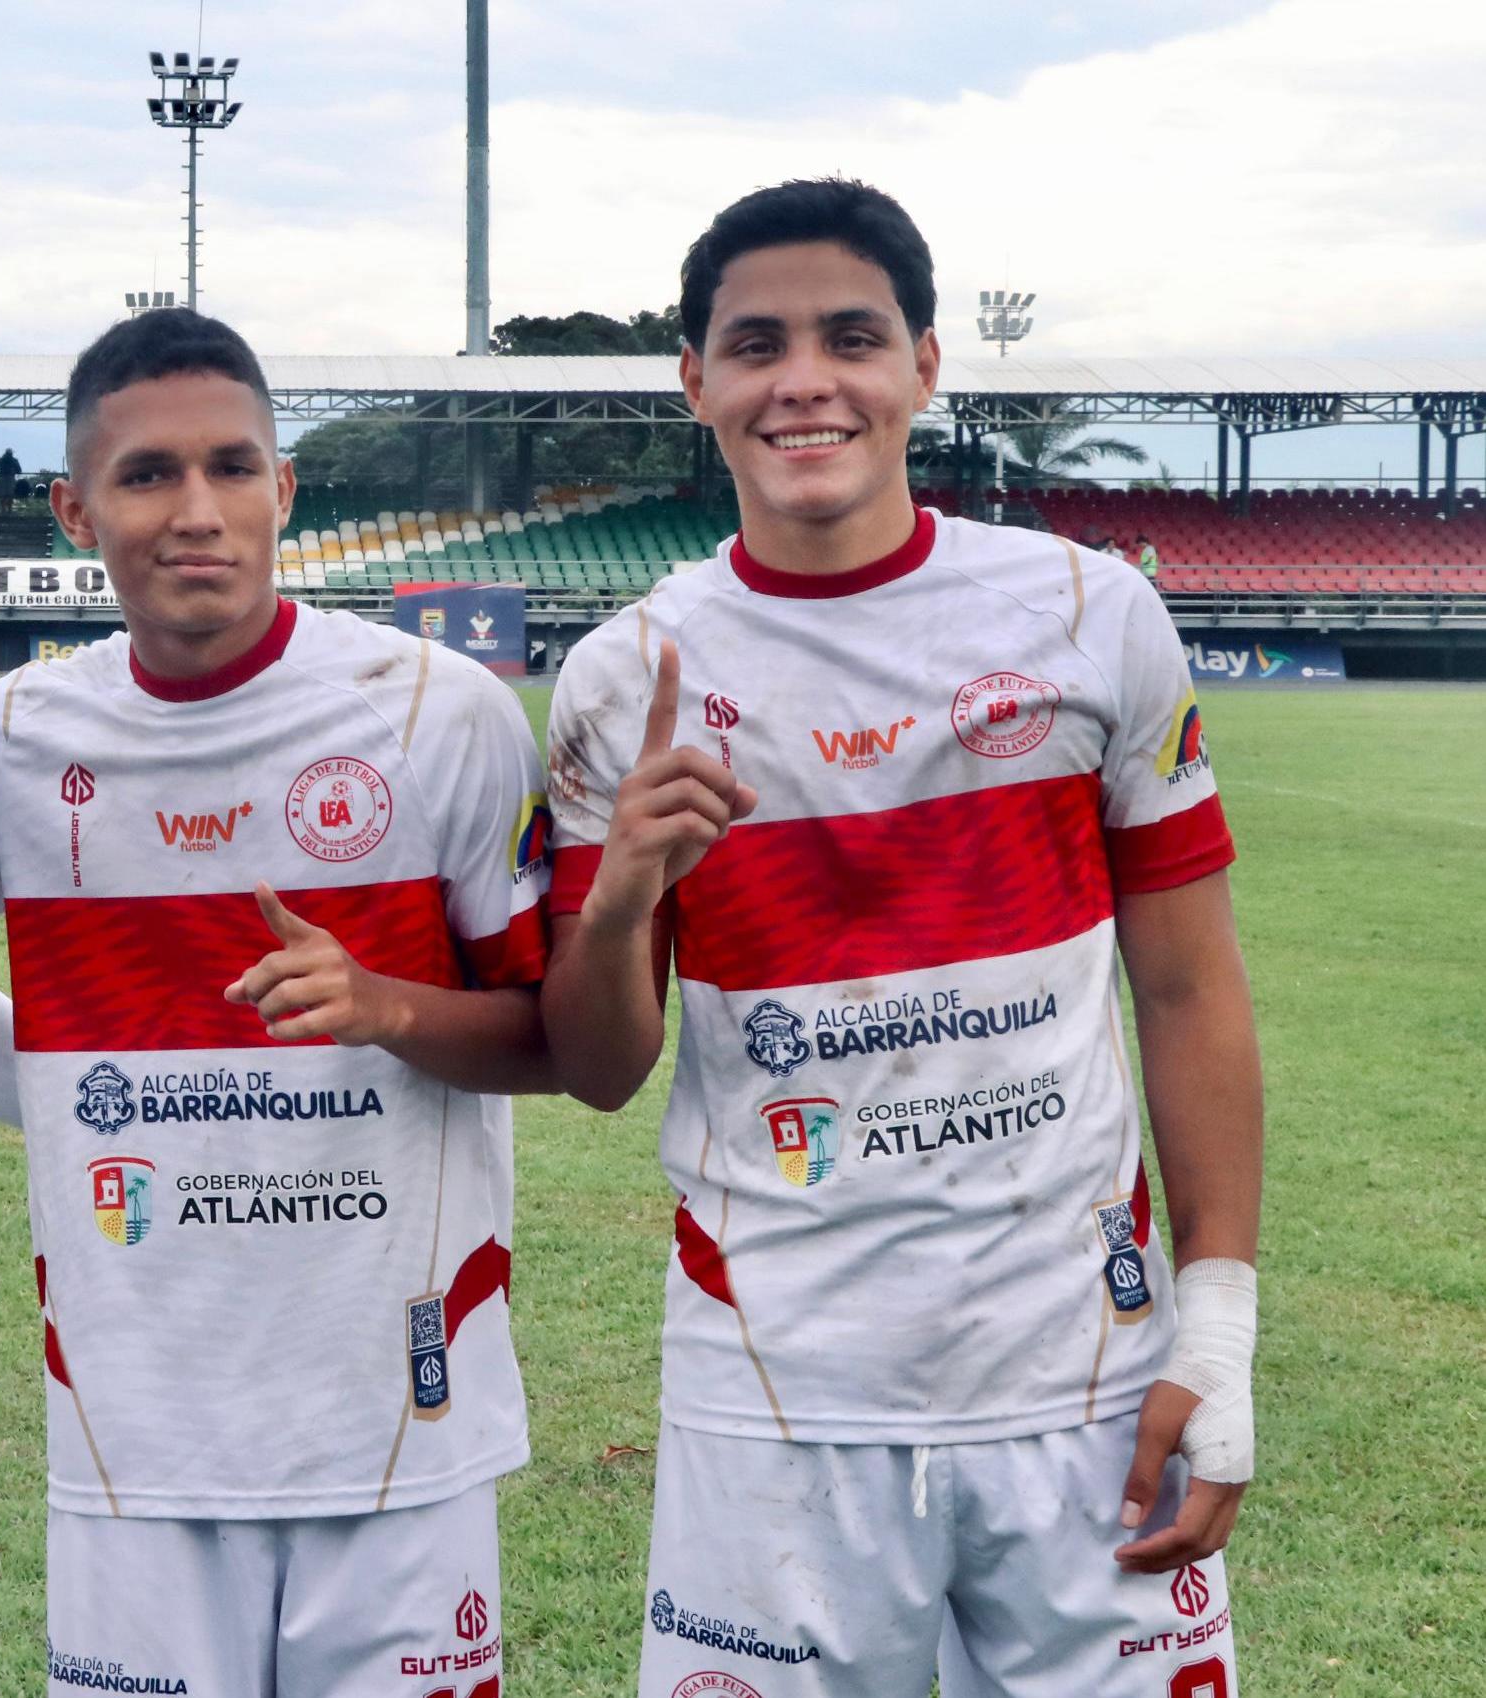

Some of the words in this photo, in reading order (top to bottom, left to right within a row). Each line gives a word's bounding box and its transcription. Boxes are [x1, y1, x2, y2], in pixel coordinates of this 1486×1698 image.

[2, 595, 53, 605] FUTBOL
[293, 774, 316, 803] LIGA
[315, 763, 333, 776] DE
[337, 762, 380, 793] FUTBOL
[71, 811, 82, 888] GUTYSPORT
[300, 834, 319, 851] DEL
[815, 991, 926, 1030] ALCALDÍA
[933, 989, 963, 1013] DE
[816, 993, 1059, 1060] BARRANQUILLA
[141, 1068, 240, 1094] ALCALDÍA
[247, 1071, 273, 1091] DE
[857, 1081, 1024, 1123] GOBERNACIÓN
[1031, 1070, 1060, 1092] DEL
[141, 1088, 384, 1123] BARRANQUILLA
[862, 1092, 1066, 1159] ATLÁNTICO
[176, 1169, 334, 1191] GOBERNACIÓN
[341, 1170, 383, 1187] DEL
[178, 1188, 388, 1226] ATLÁNTICO
[676, 1619, 820, 1664] BARRANQUILLA
[678, 1608, 736, 1636] ALCALDÍA
[740, 1625, 758, 1640] DE
[53, 1662, 188, 1695] BARRANQUILLA
[54, 1651, 104, 1672] ALCALDÍA
[108, 1662, 124, 1675] DE
[700, 1675, 720, 1687] DE
